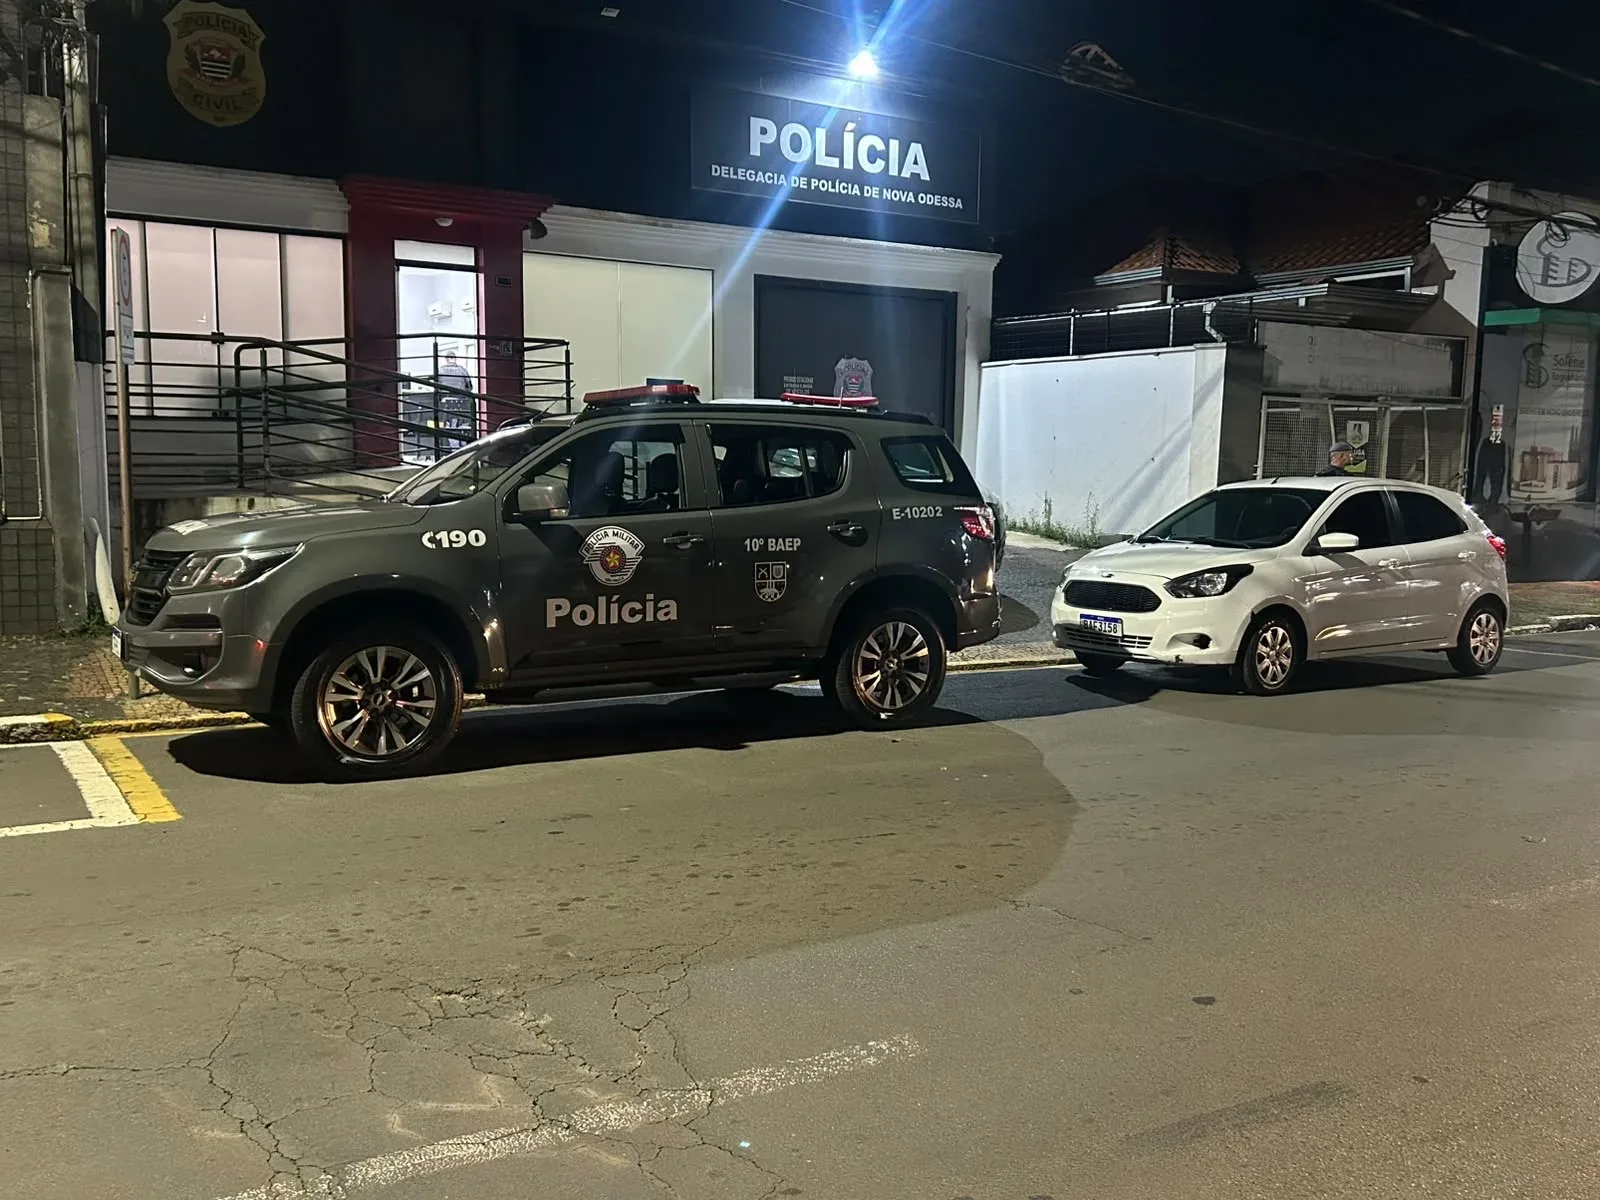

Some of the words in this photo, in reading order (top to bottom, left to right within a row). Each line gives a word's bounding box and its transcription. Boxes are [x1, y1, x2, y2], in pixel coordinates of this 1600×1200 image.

[193, 93, 243, 111] CIVIL
[749, 116, 930, 181] POLÍCIA
[711, 164, 787, 187] DELEGACIA
[791, 175, 808, 189] DE
[811, 178, 860, 196] POLÍCIA
[863, 186, 880, 199] DE
[882, 188, 915, 204] NOVA
[918, 193, 963, 209] ODESSA
[1489, 431, 1502, 444] 42
[892, 506, 943, 520] E-10202
[584, 530, 610, 554] POLÍCIA
[612, 530, 640, 551] MILITAR
[767, 537, 801, 551] BAEP
[546, 593, 678, 628] Polícia
